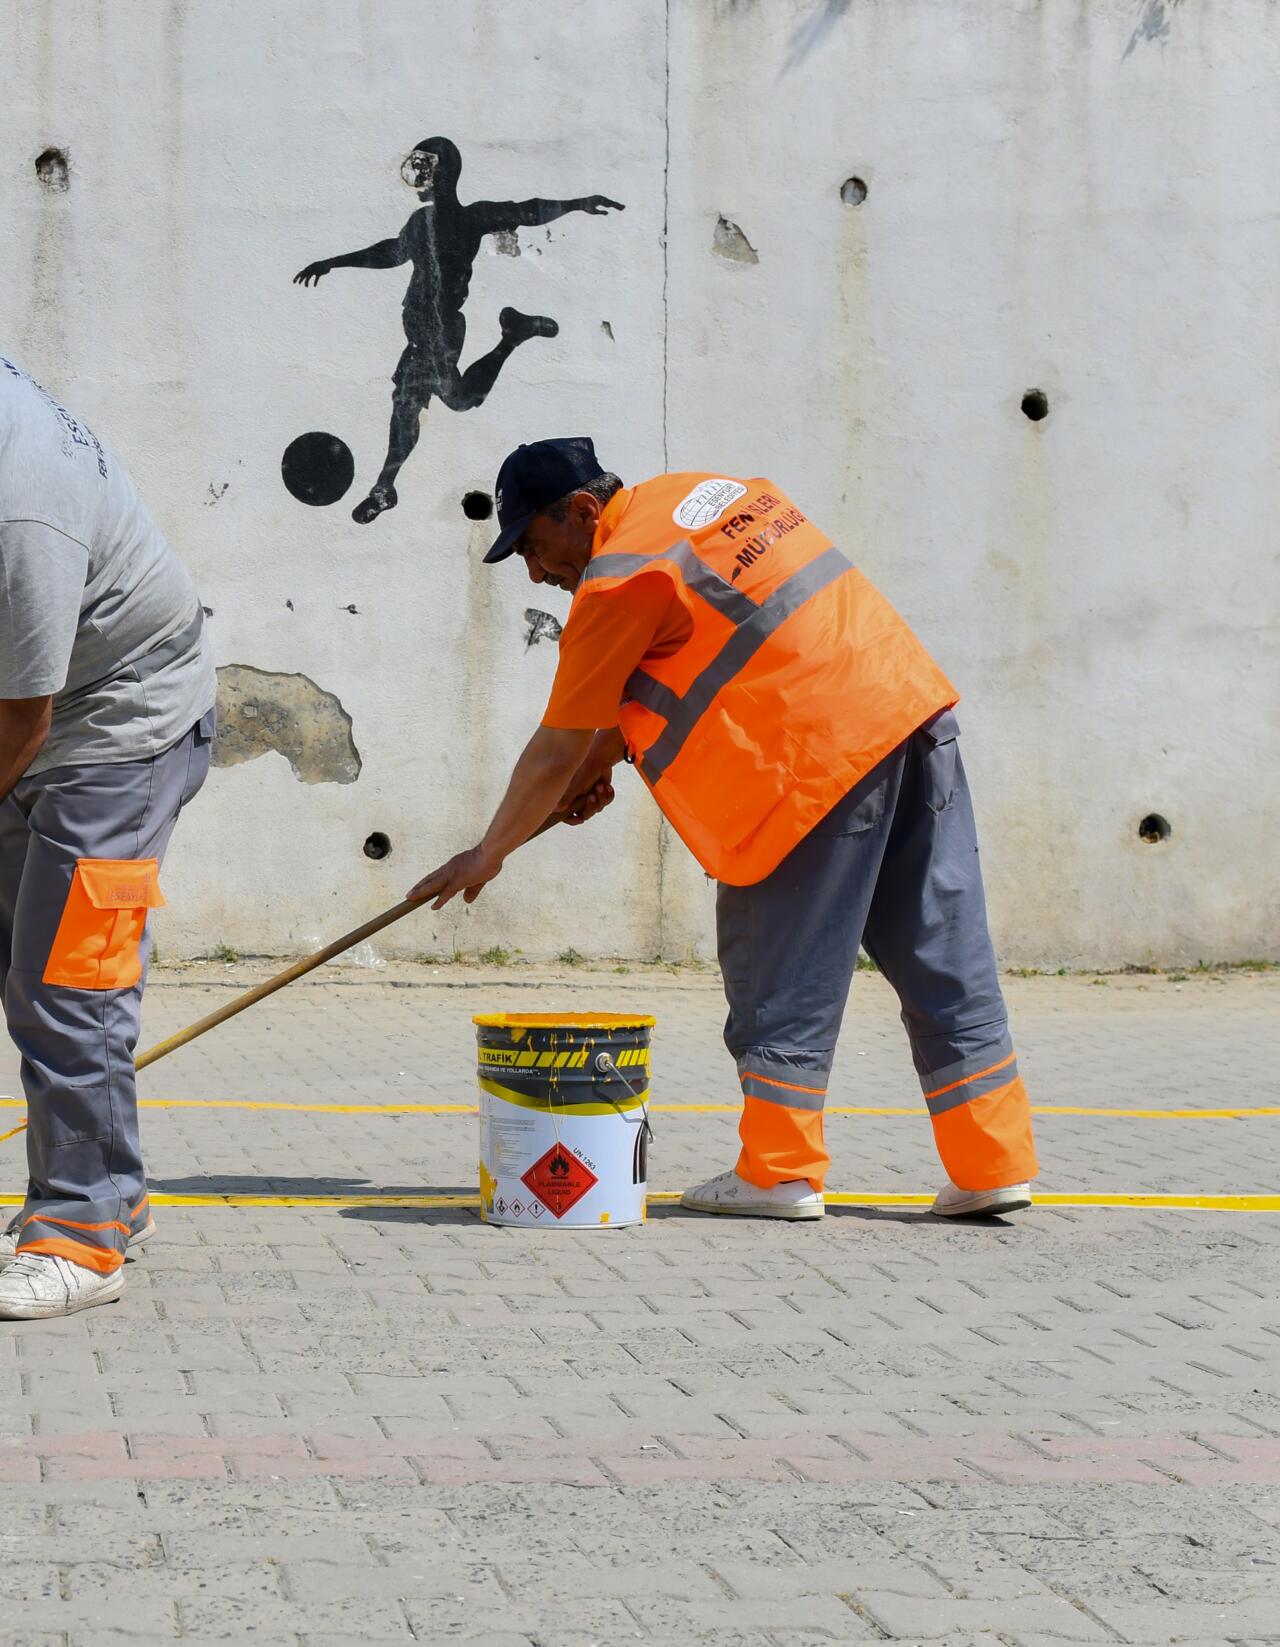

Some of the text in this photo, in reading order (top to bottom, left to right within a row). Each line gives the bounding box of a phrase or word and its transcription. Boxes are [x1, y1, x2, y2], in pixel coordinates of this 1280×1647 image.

[720, 512, 755, 541] FEN
[482, 1052, 513, 1064] TRAFİK
[572, 1147, 597, 1171] UN 1263
